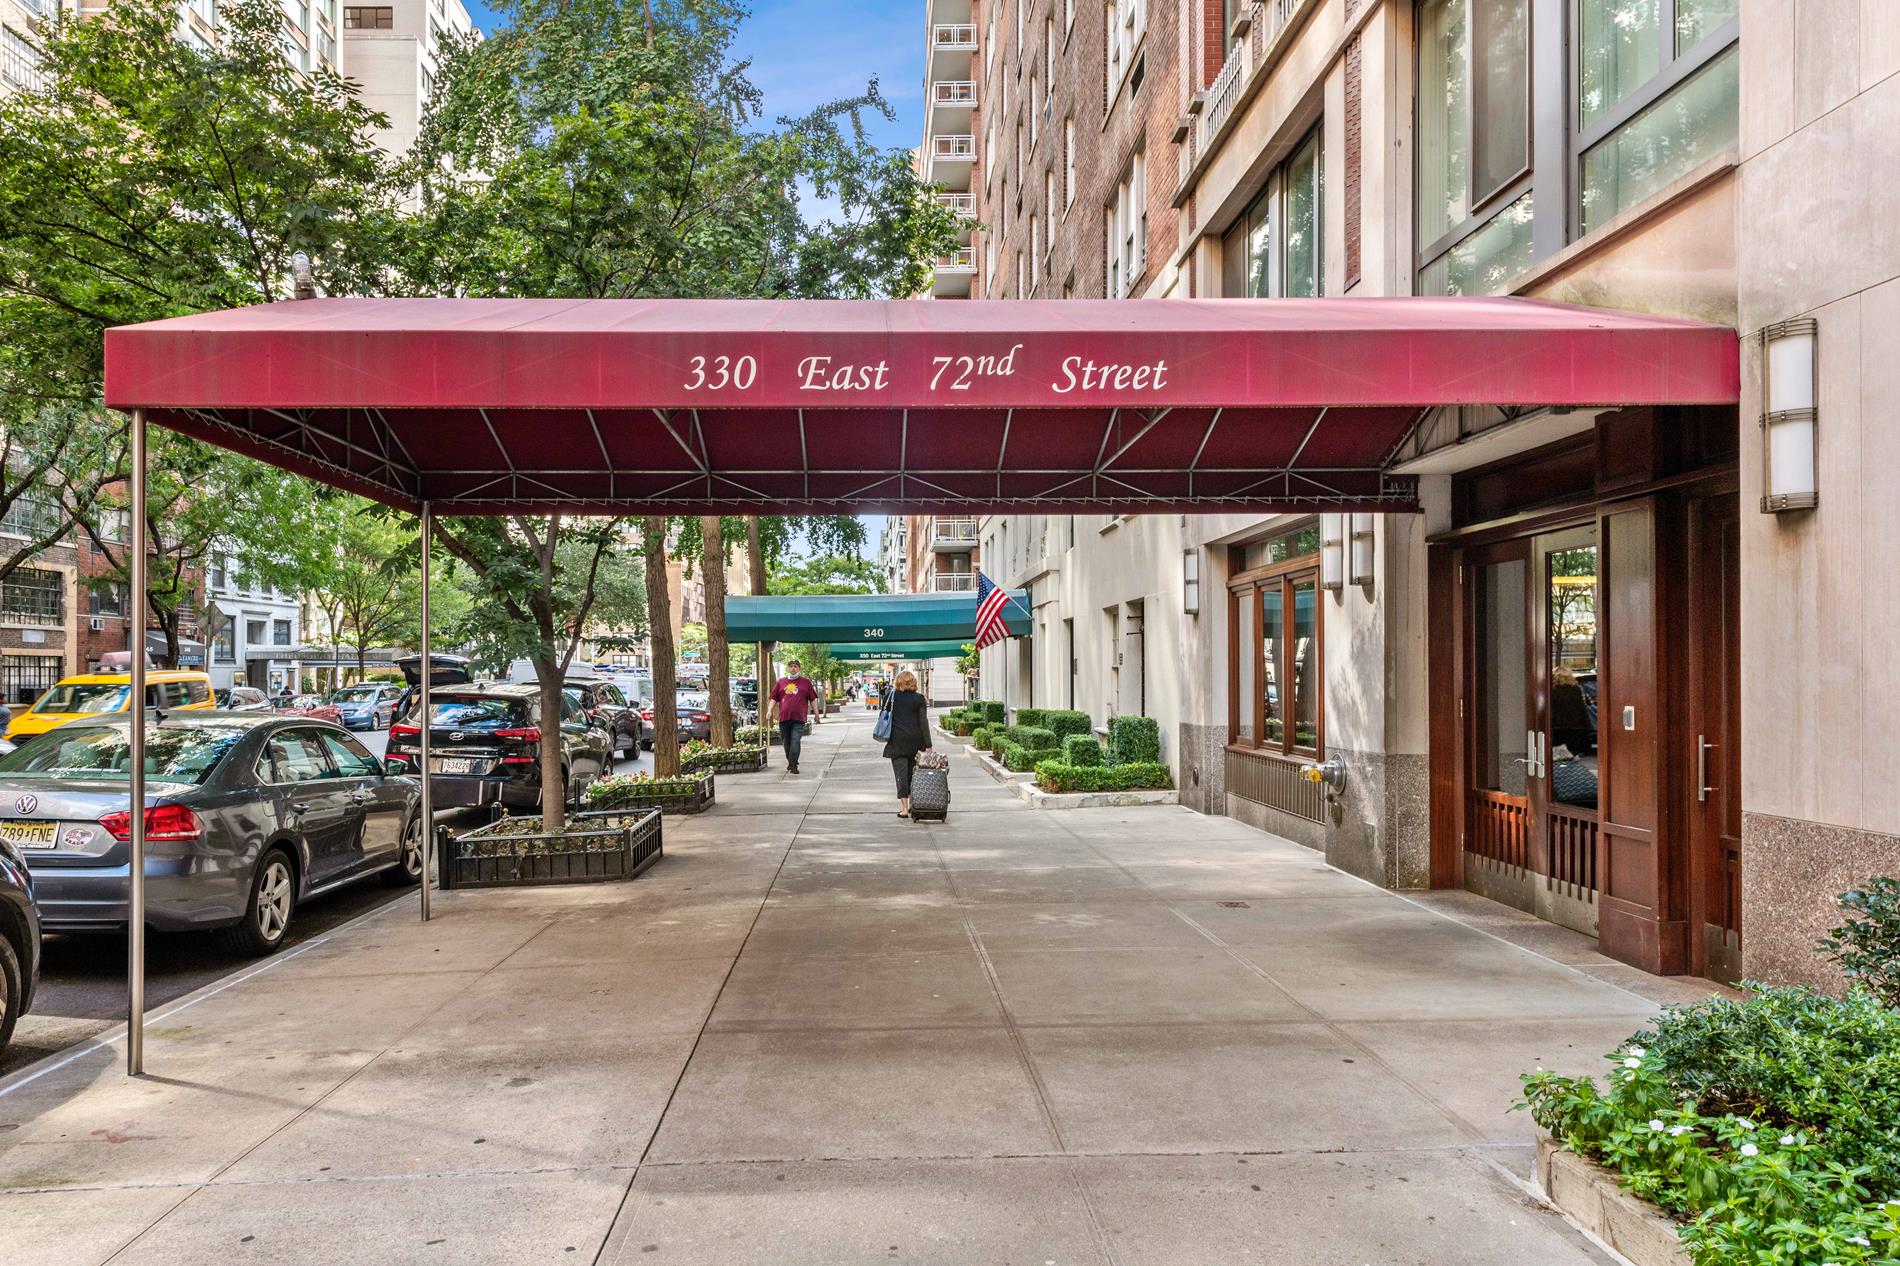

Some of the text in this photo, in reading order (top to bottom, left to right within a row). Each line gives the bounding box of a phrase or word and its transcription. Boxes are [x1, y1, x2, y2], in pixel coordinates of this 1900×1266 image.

[683, 344, 1168, 393] 330 East 72nd Street
[863, 628, 884, 638] 340
